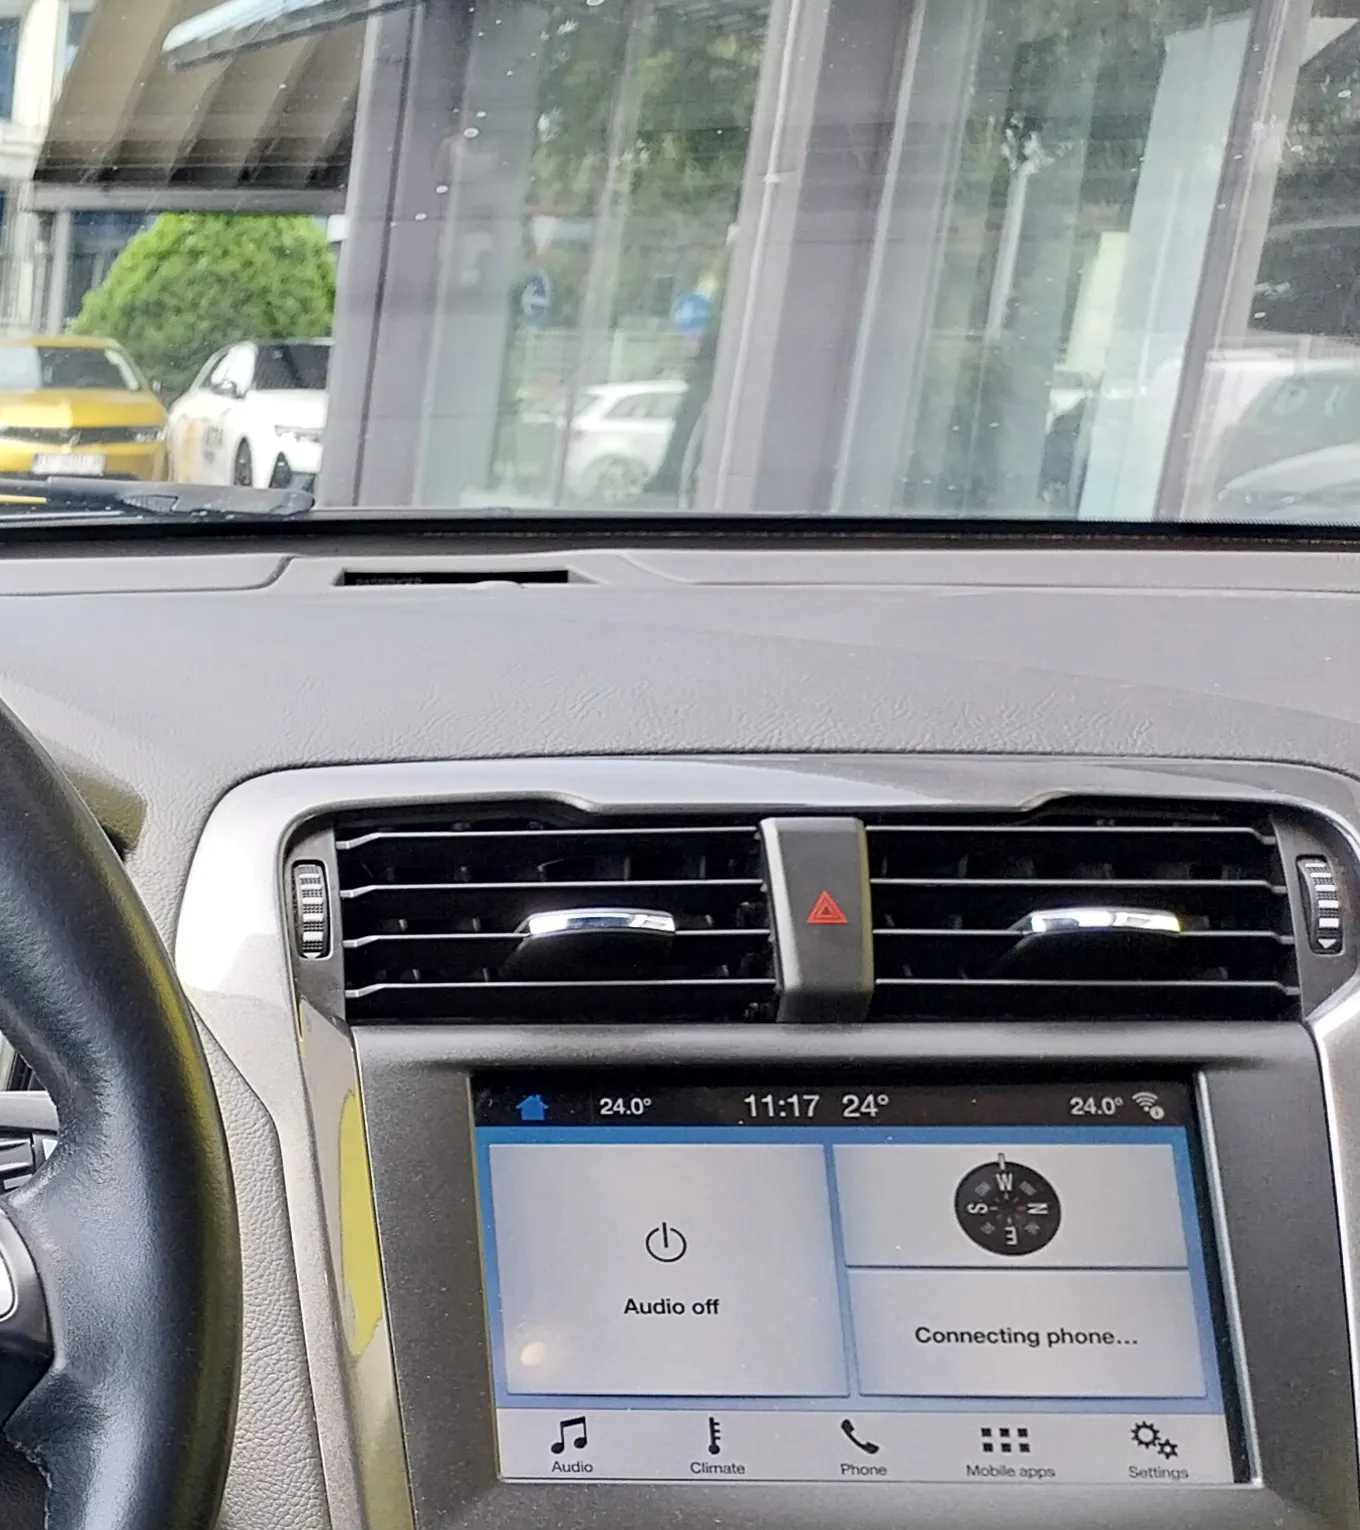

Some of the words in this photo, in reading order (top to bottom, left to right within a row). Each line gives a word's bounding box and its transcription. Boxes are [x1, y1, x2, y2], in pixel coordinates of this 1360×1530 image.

[599, 1095, 652, 1118] 24.0°
[743, 1093, 819, 1119] 11:17
[841, 1093, 890, 1119] 24°
[1070, 1094, 1123, 1118] 24.0°
[995, 1172, 1014, 1191] W
[623, 1298, 685, 1316] Audio
[691, 1298, 720, 1316] off
[914, 1326, 1041, 1349] Connecting
[1047, 1327, 1139, 1349] phone...
[551, 1460, 594, 1475] Audio
[690, 1461, 746, 1476] Climate
[840, 1462, 887, 1477] Phone
[966, 1464, 1016, 1479] Mobile
[1019, 1468, 1056, 1482] apps
[1129, 1465, 1188, 1482] Settings
